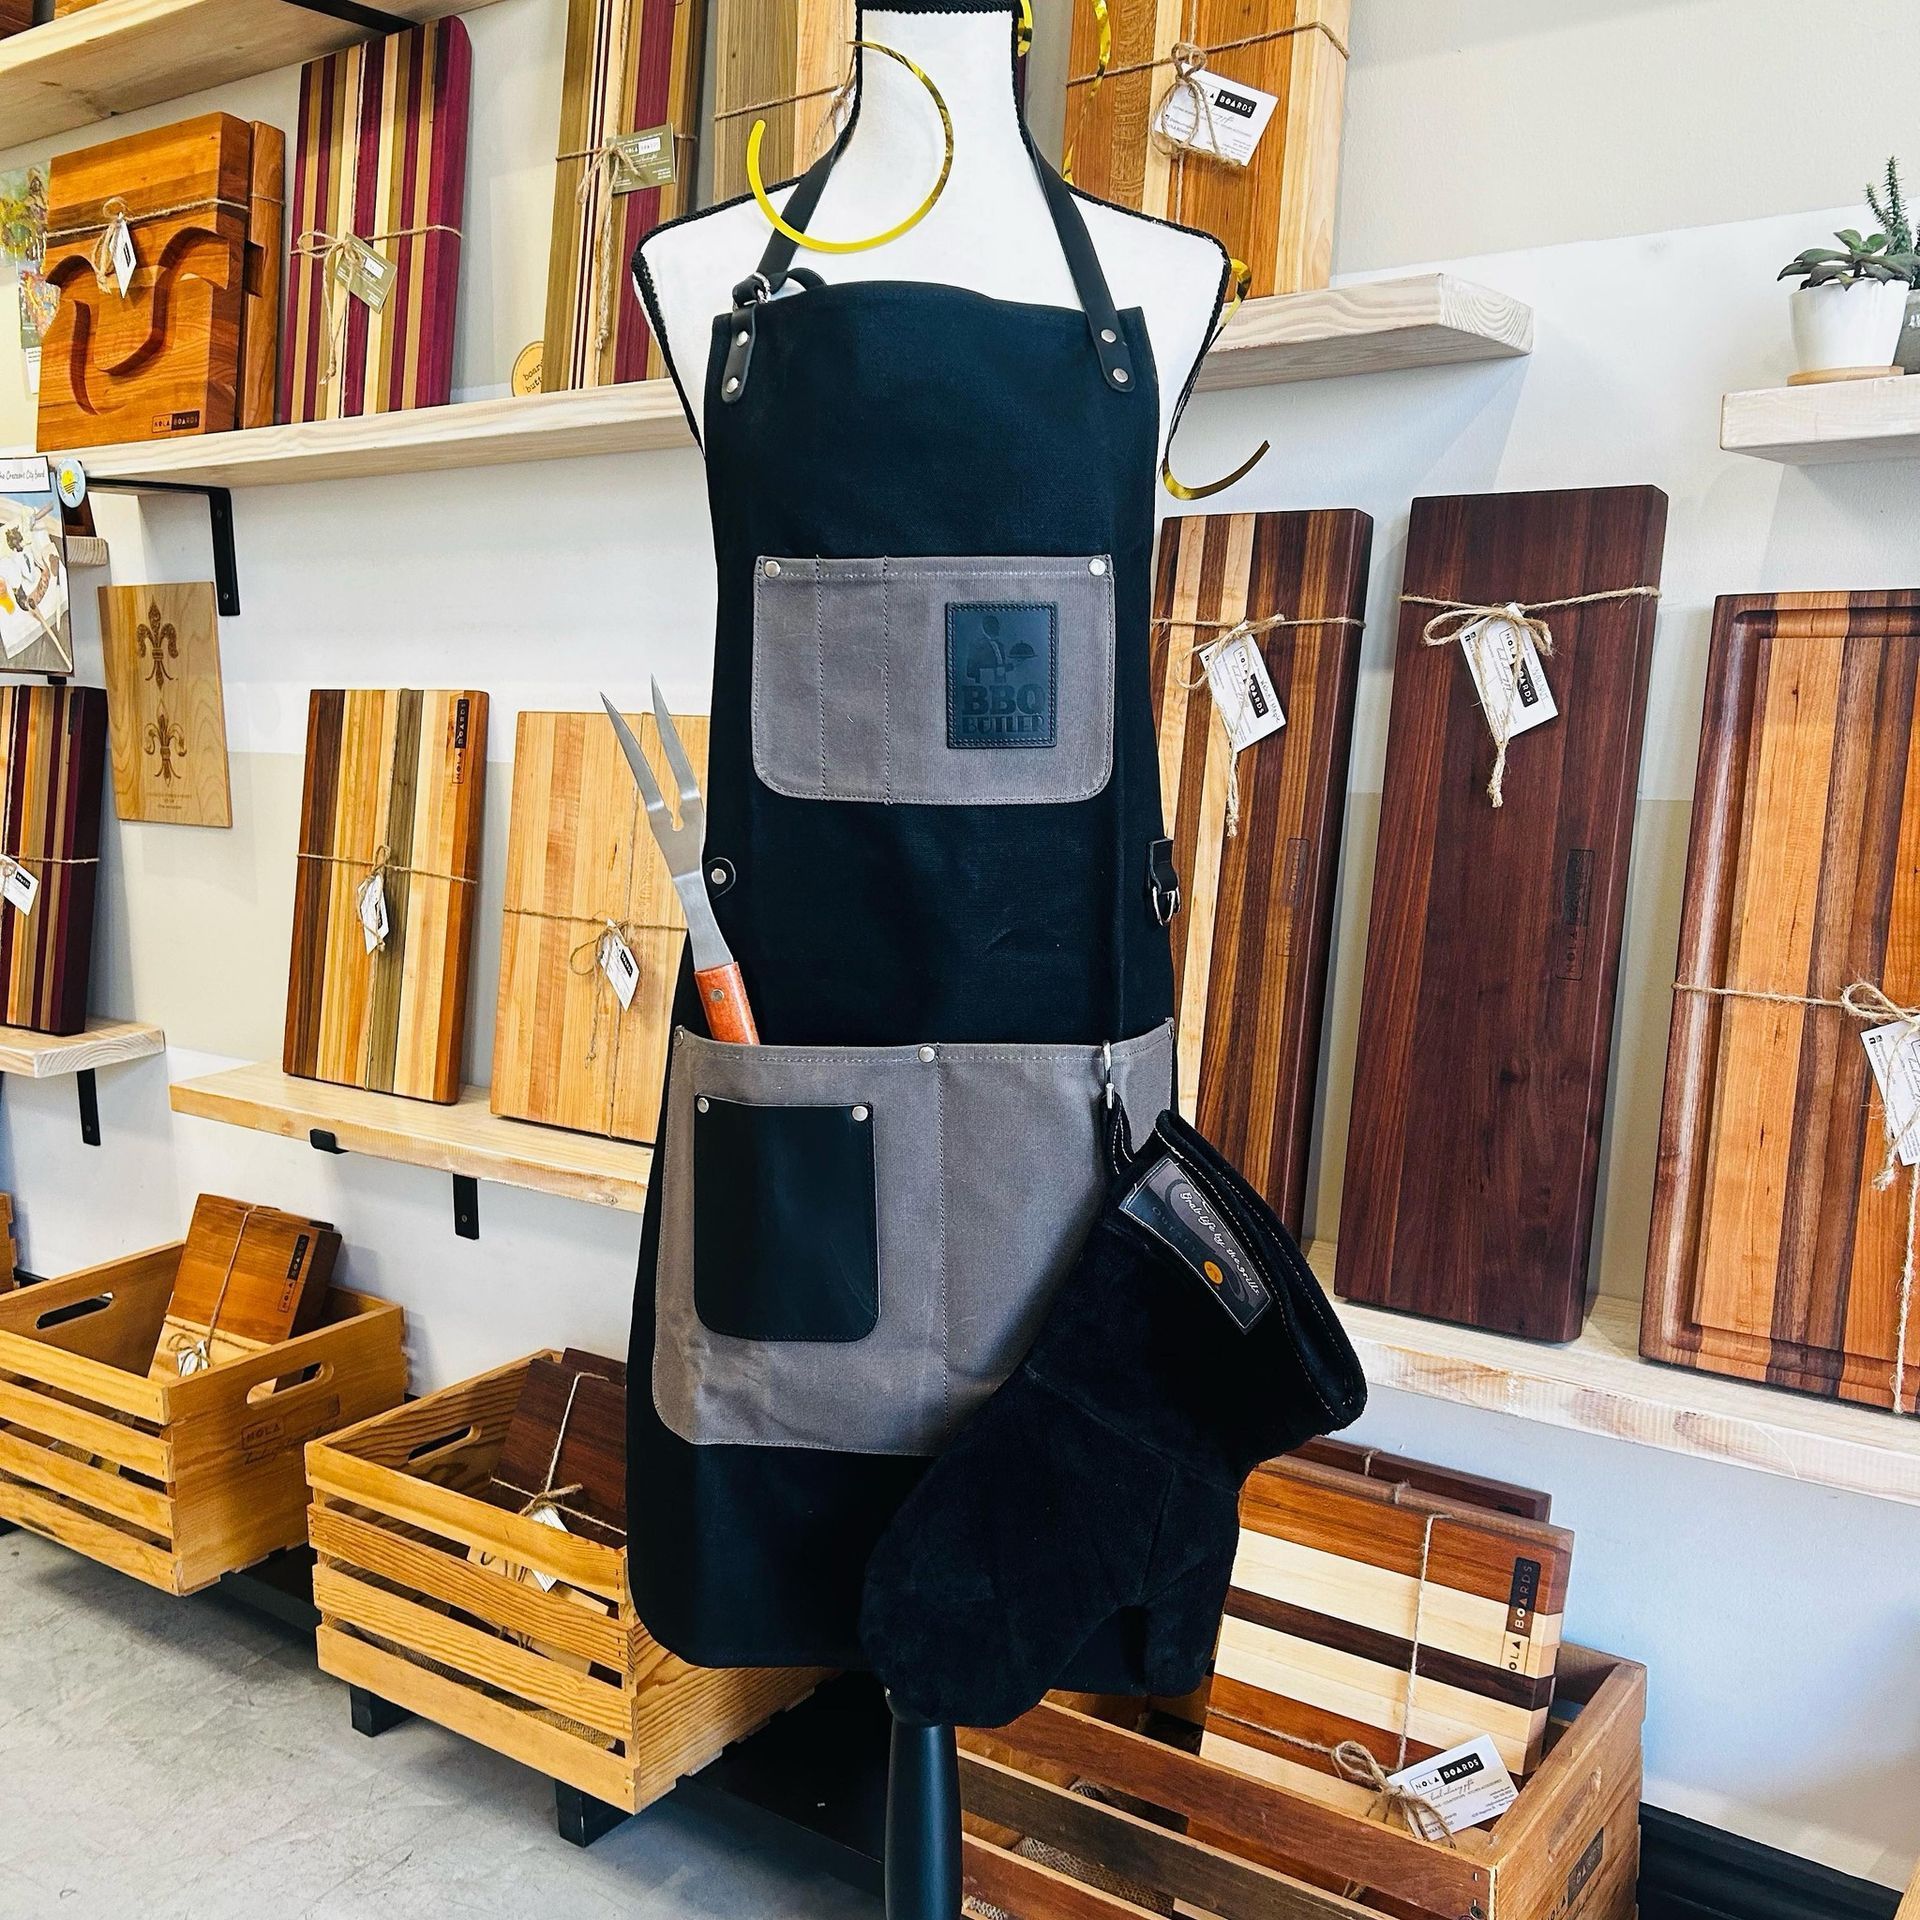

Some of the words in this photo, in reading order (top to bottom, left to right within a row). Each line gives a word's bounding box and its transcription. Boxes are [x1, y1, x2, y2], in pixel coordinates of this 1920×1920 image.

[1219, 95, 1253, 113] BOARDS
[523, 359, 543, 381] boar
[525, 376, 542, 393] butt
[961, 684, 1046, 715] BBQ
[1517, 668, 1535, 703] OARDS
[961, 715, 1045, 734] BUTLER
[1180, 1192, 1202, 1217] Grab
[1198, 1216, 1216, 1232] life
[1213, 1232, 1225, 1248] by
[1226, 1248, 1240, 1263] the
[1509, 1641, 1521, 1671] OLA
[1515, 1565, 1532, 1629] BOARDS
[1415, 1776, 1439, 1789] NOLA
[1443, 1759, 1479, 1779] BOARDS
